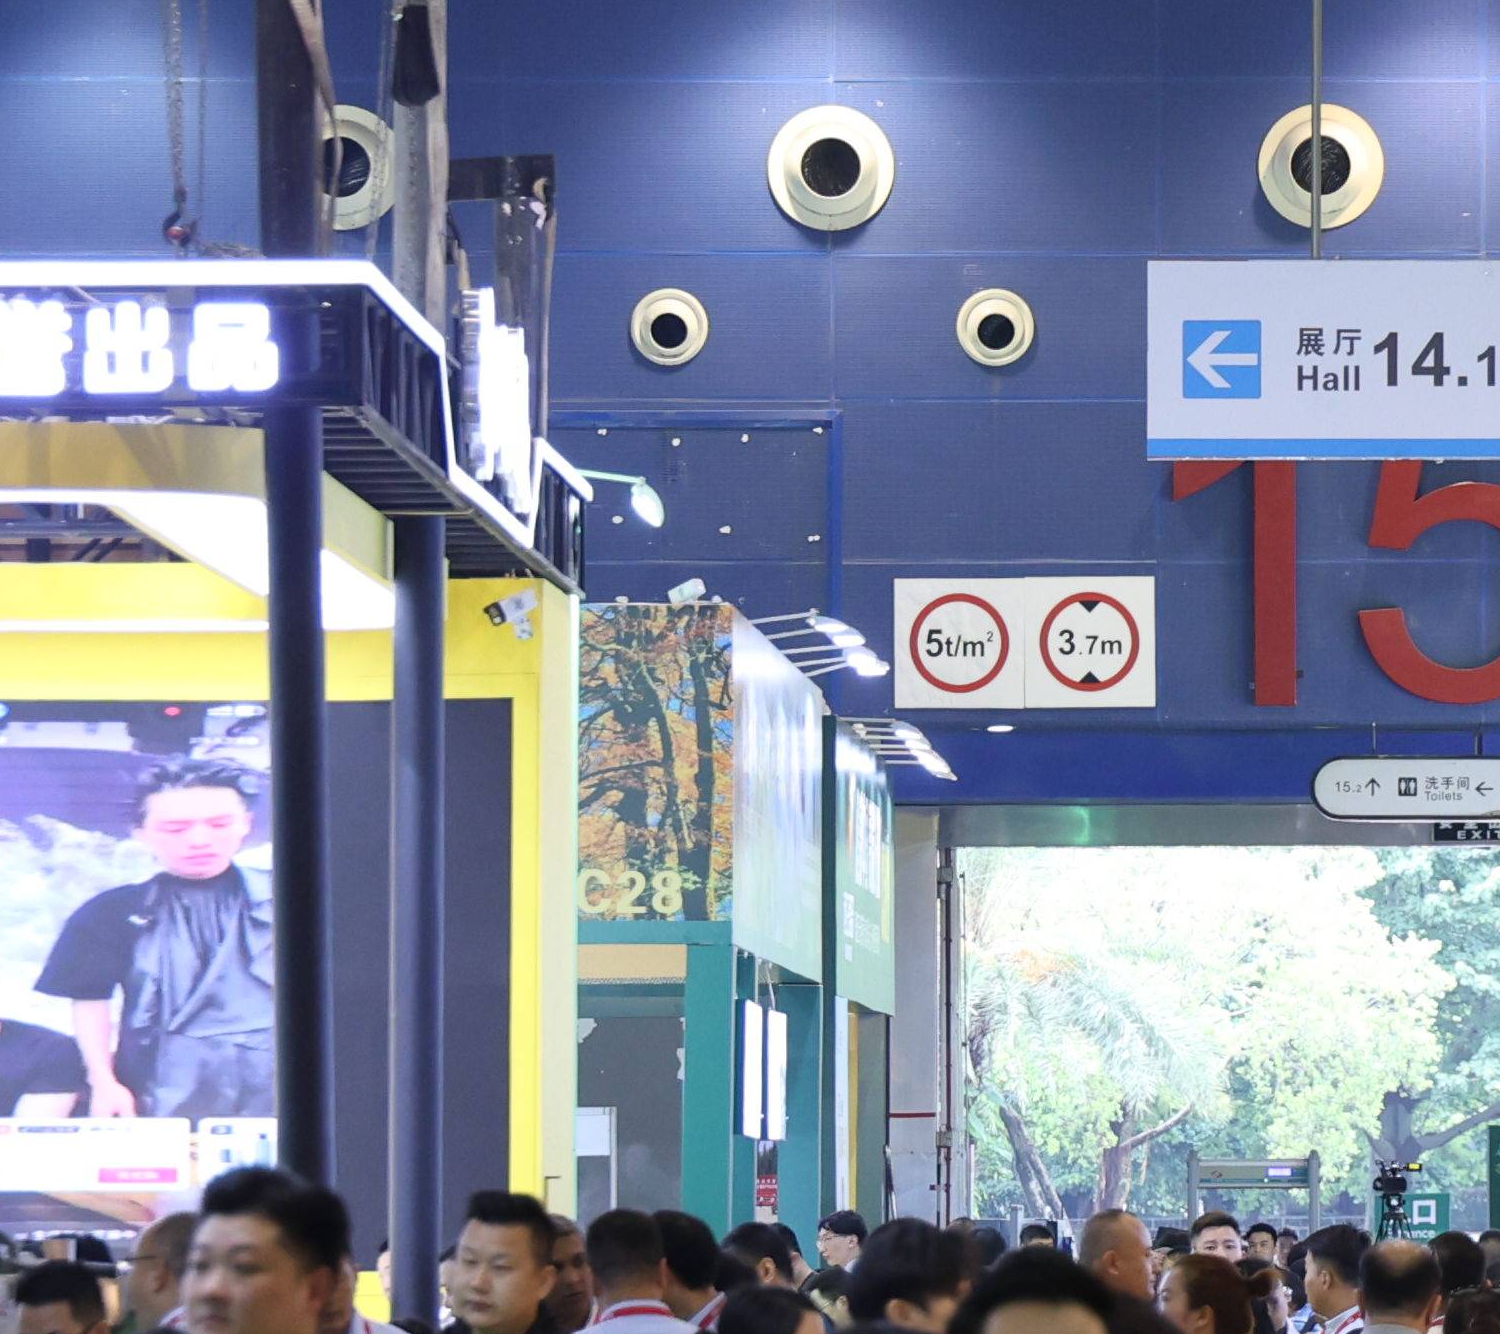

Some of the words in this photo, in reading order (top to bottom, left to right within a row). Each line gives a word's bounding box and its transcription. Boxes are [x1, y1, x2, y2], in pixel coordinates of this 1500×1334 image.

[1296, 327, 1362, 357] 展厅
[1296, 365, 1361, 392] Hall
[1373, 332, 1497, 388] 14.1
[1058, 629, 1123, 655] 3.7m
[1334, 780, 1363, 794] 15.2
[1424, 776, 1470, 790] 洗手间
[1425, 791, 1463, 802] Toilets
